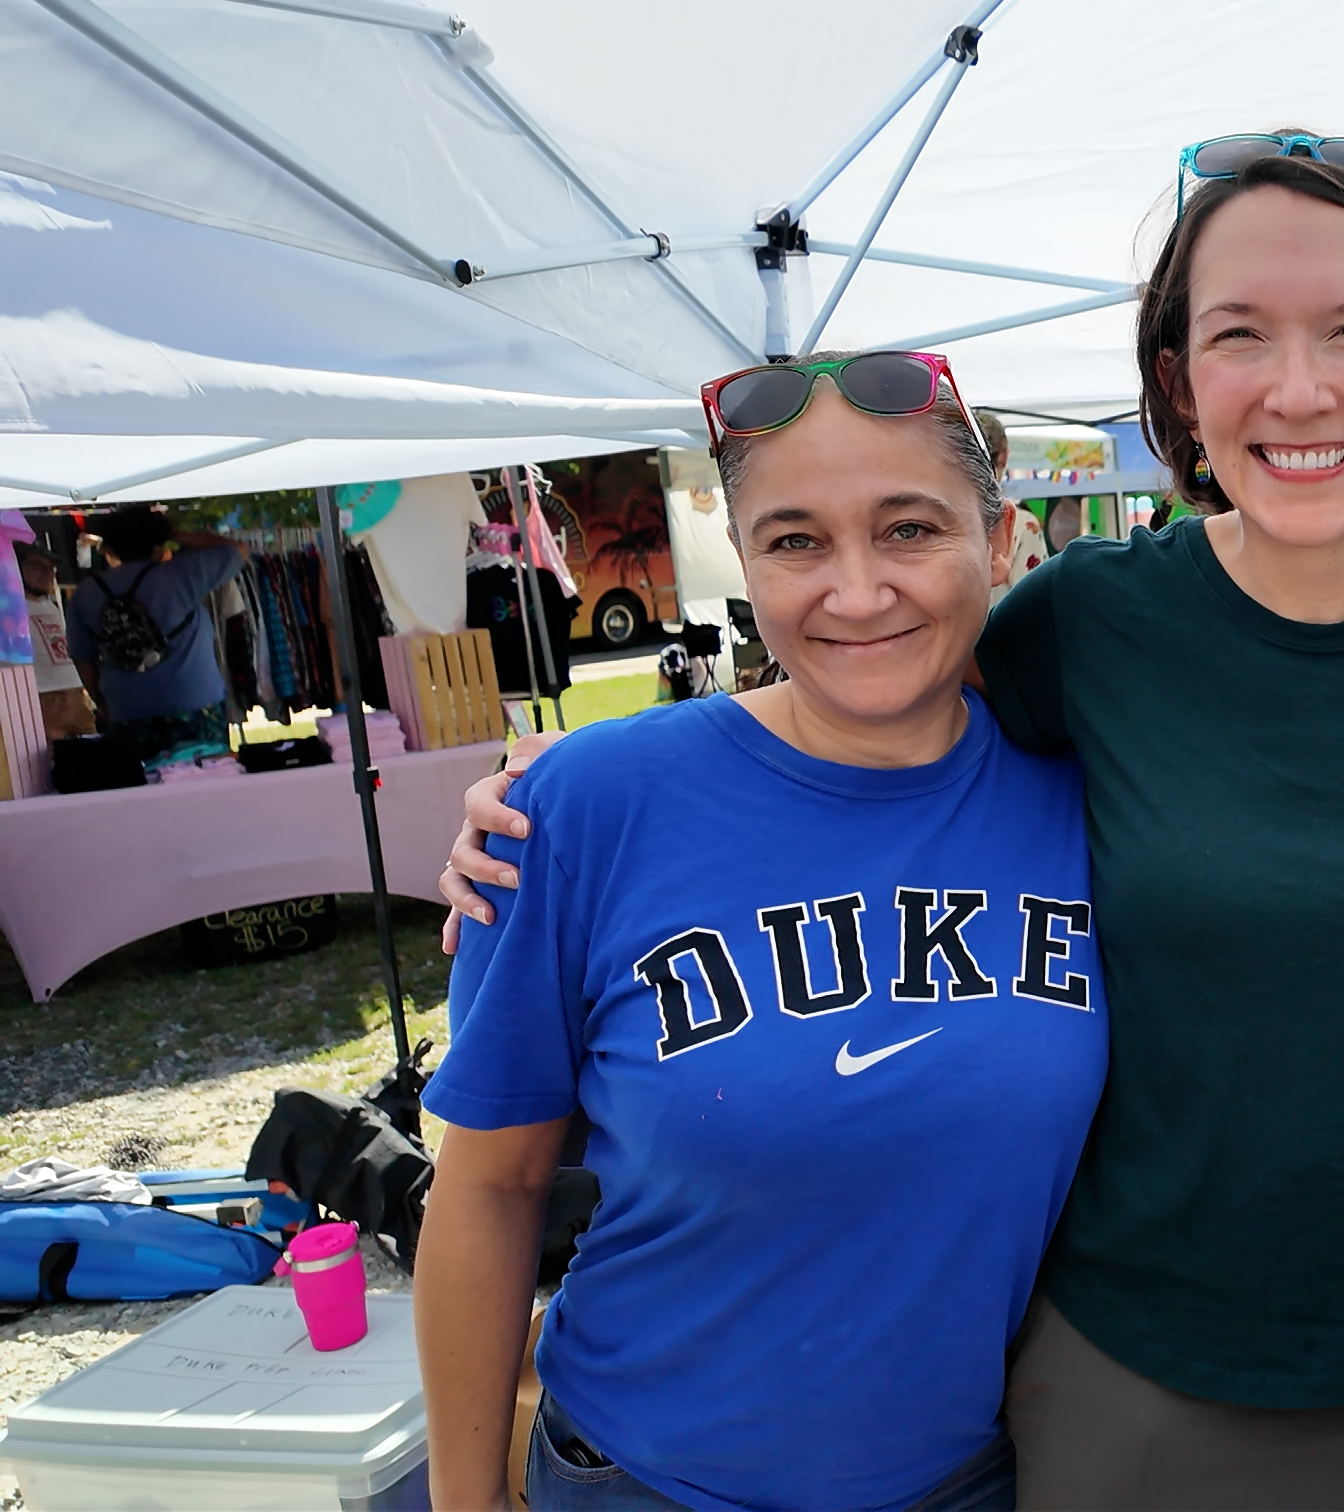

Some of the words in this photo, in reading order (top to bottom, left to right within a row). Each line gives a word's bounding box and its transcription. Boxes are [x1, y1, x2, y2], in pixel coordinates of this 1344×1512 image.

[204, 895, 325, 930] Clearance
[234, 923, 308, 952] $15
[633, 886, 1091, 1062] DUKE
